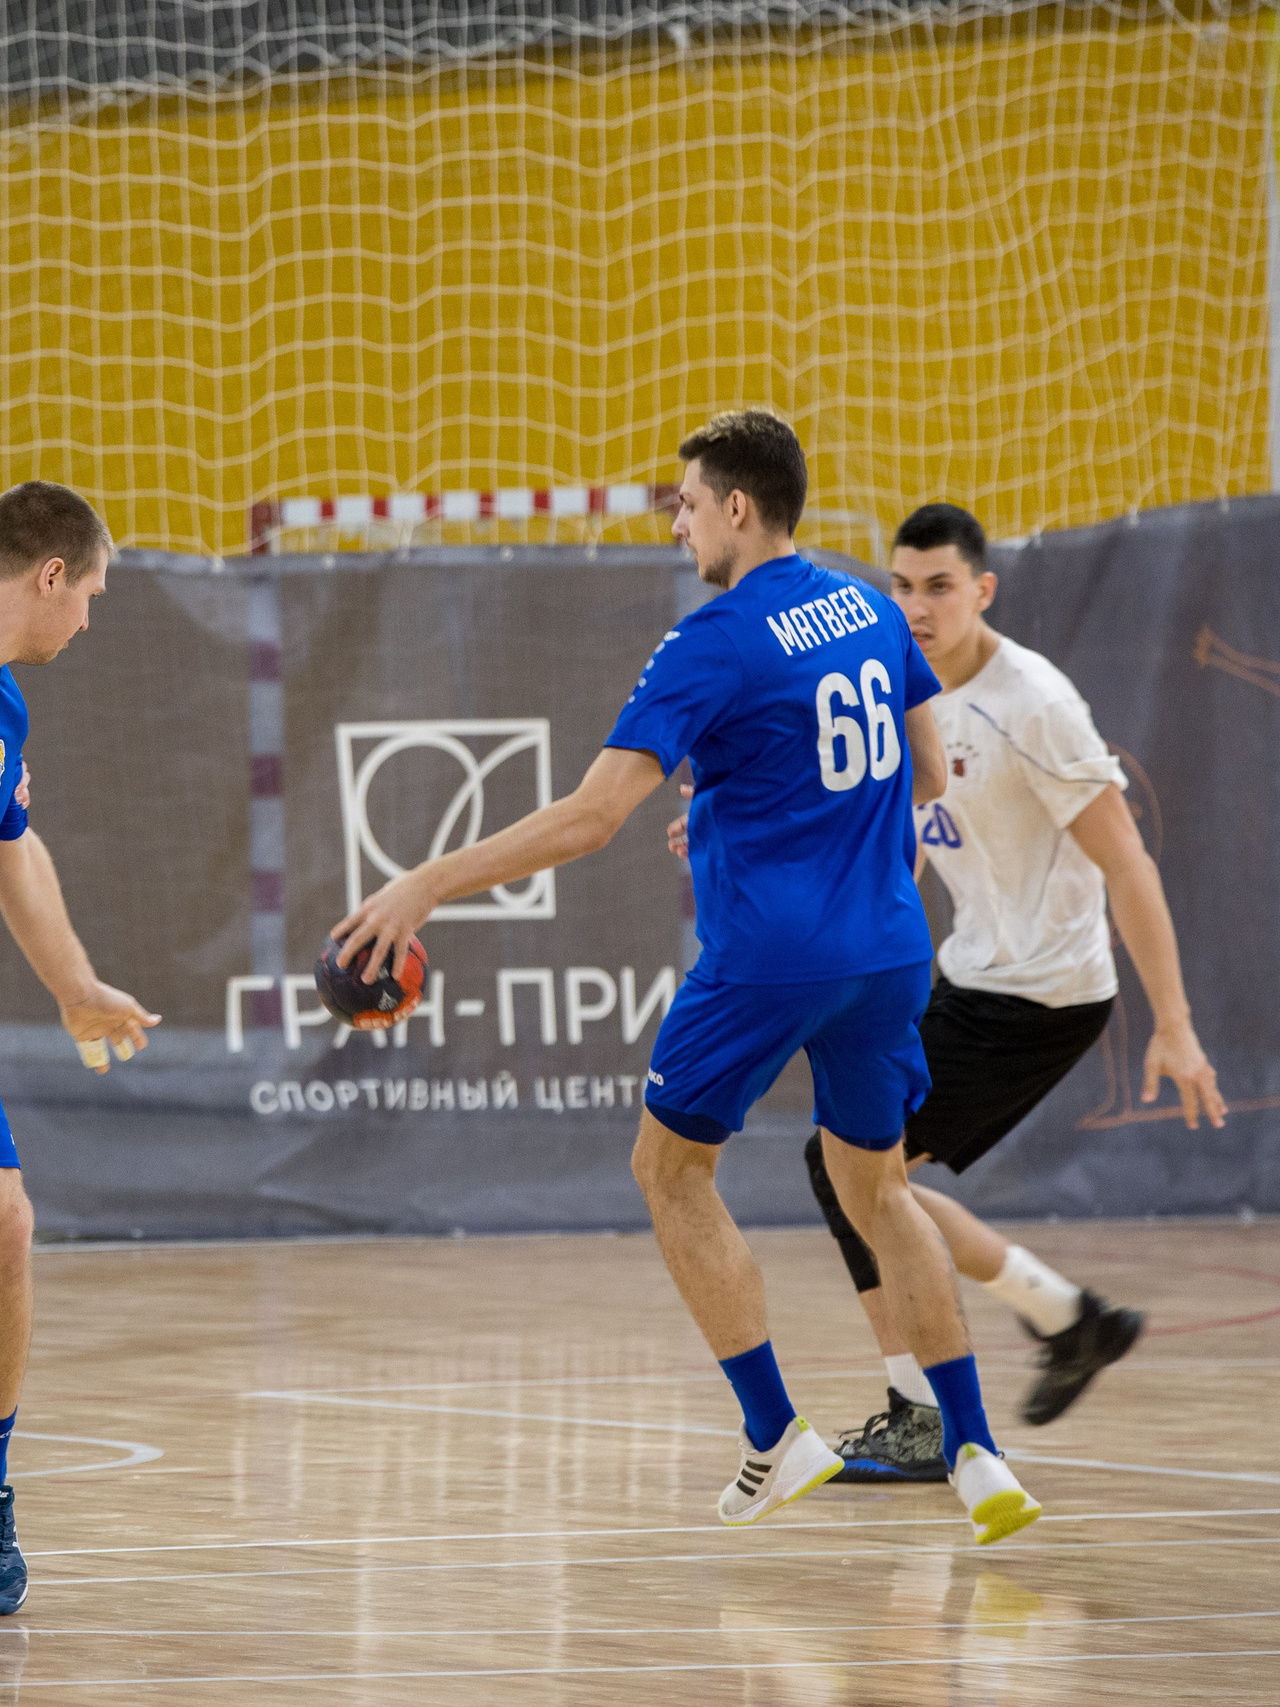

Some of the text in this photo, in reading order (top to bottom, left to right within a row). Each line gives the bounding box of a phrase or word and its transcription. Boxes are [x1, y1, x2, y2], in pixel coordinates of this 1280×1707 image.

[766, 585, 879, 656] МАТВЕЕВ
[815, 658, 902, 792] 66
[249, 1070, 648, 1115] СПОРТИВНЫЙ ЦЕНТ
